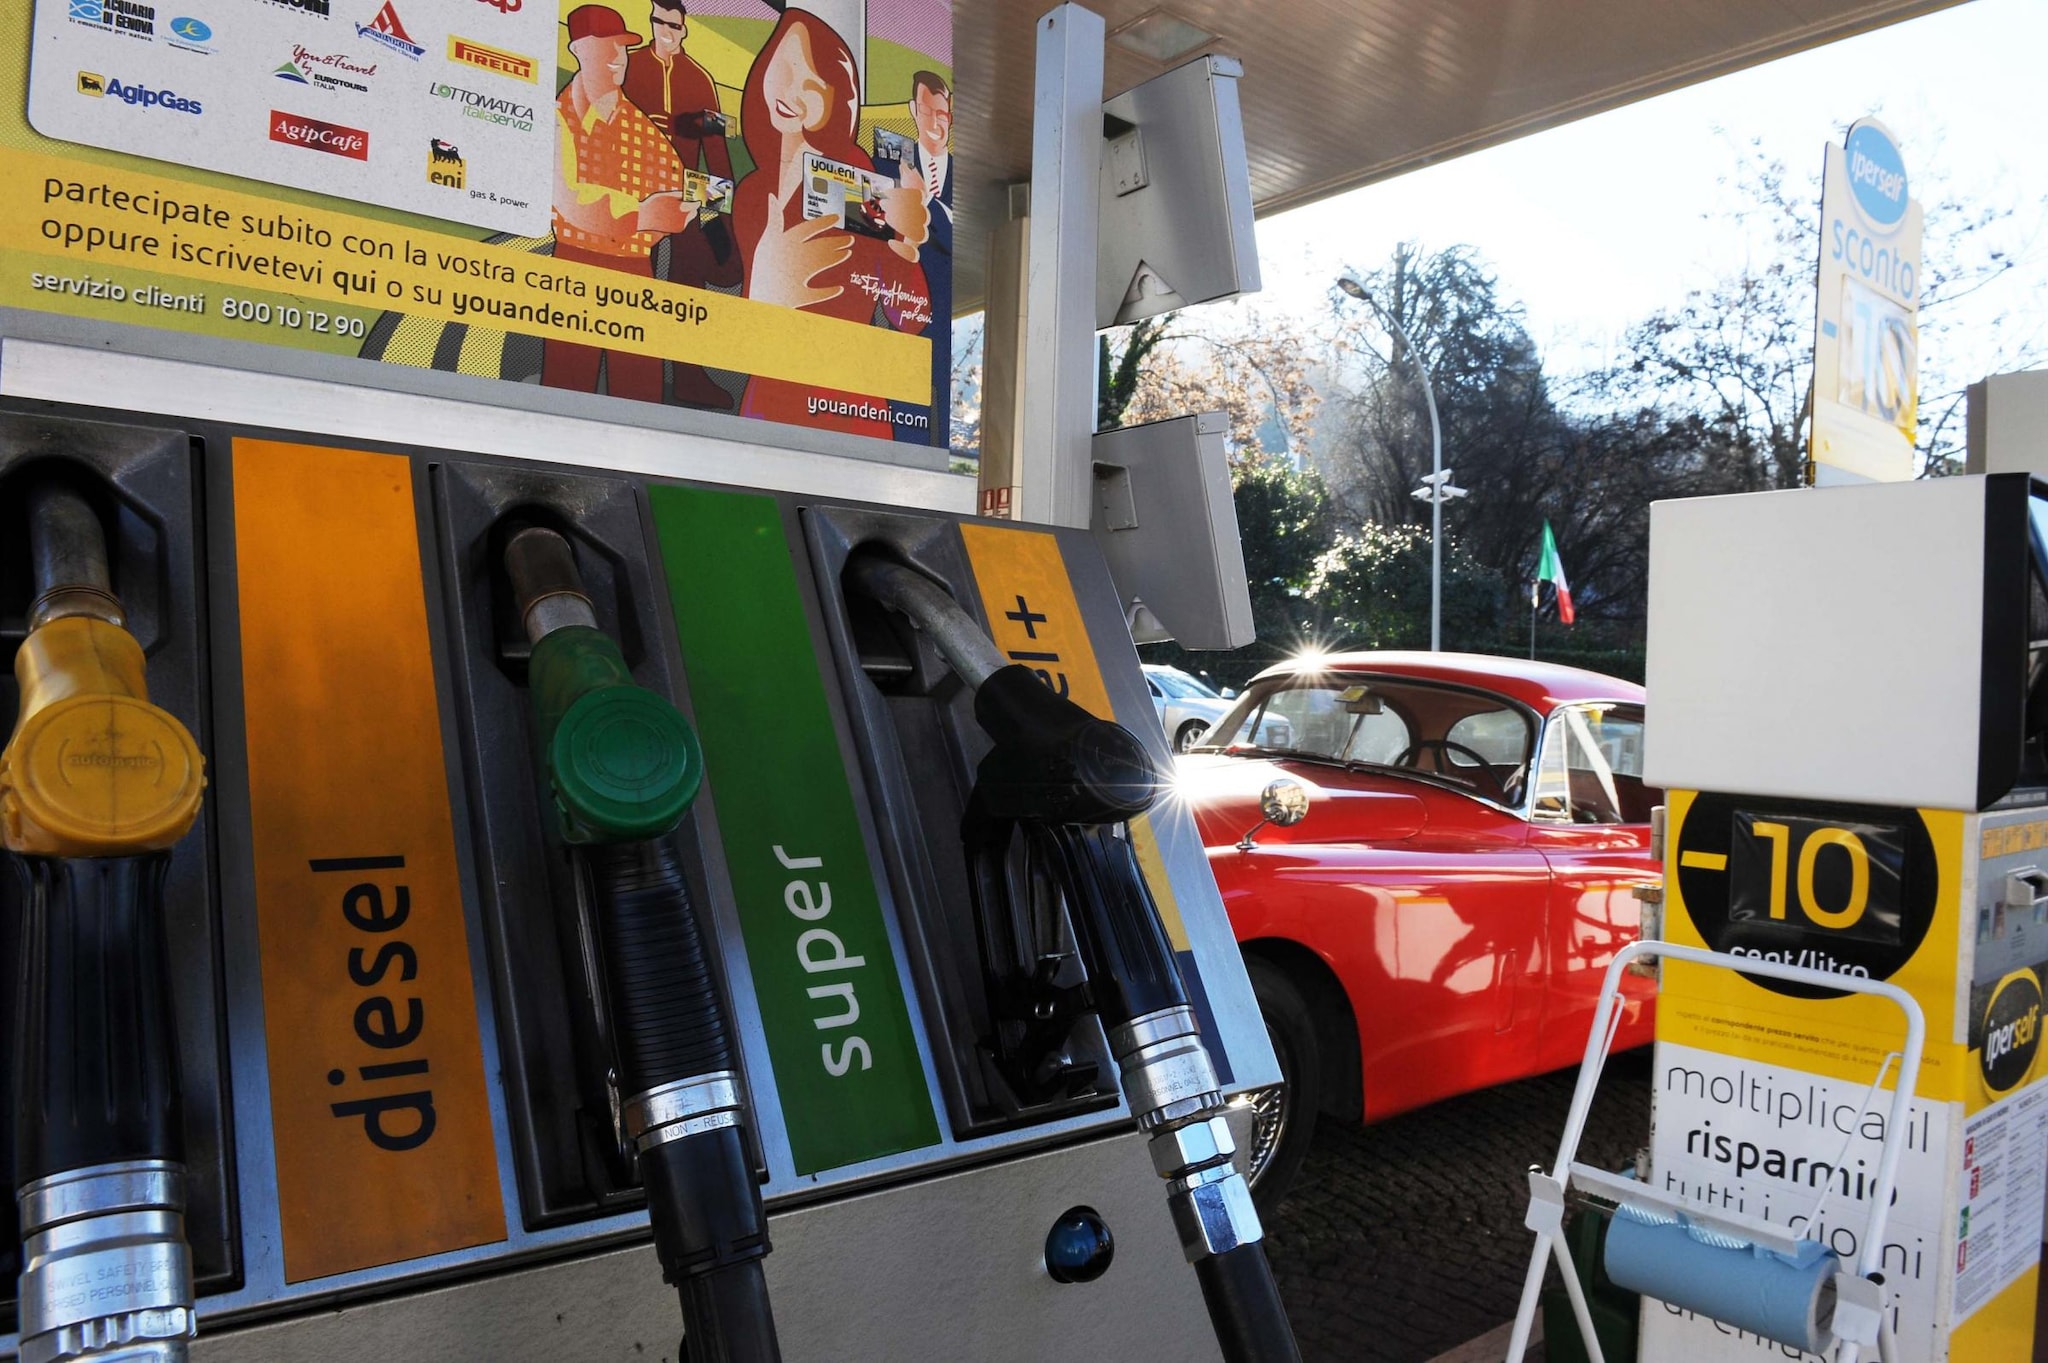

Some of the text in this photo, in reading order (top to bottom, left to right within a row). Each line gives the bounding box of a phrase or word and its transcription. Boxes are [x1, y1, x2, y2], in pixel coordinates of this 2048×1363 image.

[103, 11, 154, 35] DI GENOVA
[104, 0, 155, 20] ACQUARIO
[302, 61, 313, 75] by
[455, 41, 531, 78] PIRELLI
[106, 78, 202, 115] AgipGas
[313, 82, 336, 91] ITALIA
[314, 74, 368, 92] EUROTOURS
[430, 82, 533, 121] LOTTOMATICA
[274, 119, 363, 151] AgipCafé
[431, 171, 462, 189] eni
[1851, 140, 1904, 202] iperself
[470, 190, 529, 208] gas & power
[44, 178, 708, 325] partecipate subito con la vostra carta you&agip
[1832, 219, 1914, 300] sconto
[41, 219, 645, 342] oppure iscrivetevi qui o su youandeni.com
[31, 270, 365, 338] servizio clienti 800 10 12 90
[807, 396, 928, 428] youandeni.com
[772, 844, 873, 1077] super
[309, 855, 438, 1151] diesel
[1986, 1004, 2039, 1071] iperself
[1668, 1067, 1884, 1142] moltiplica
[1909, 1108, 1928, 1153] il
[664, 1123, 688, 1139] NON
[49, 1271, 91, 1293] SWIVEL
[97, 1260, 146, 1281] SAFETY
[90, 1279, 157, 1300] PERSONNEL
